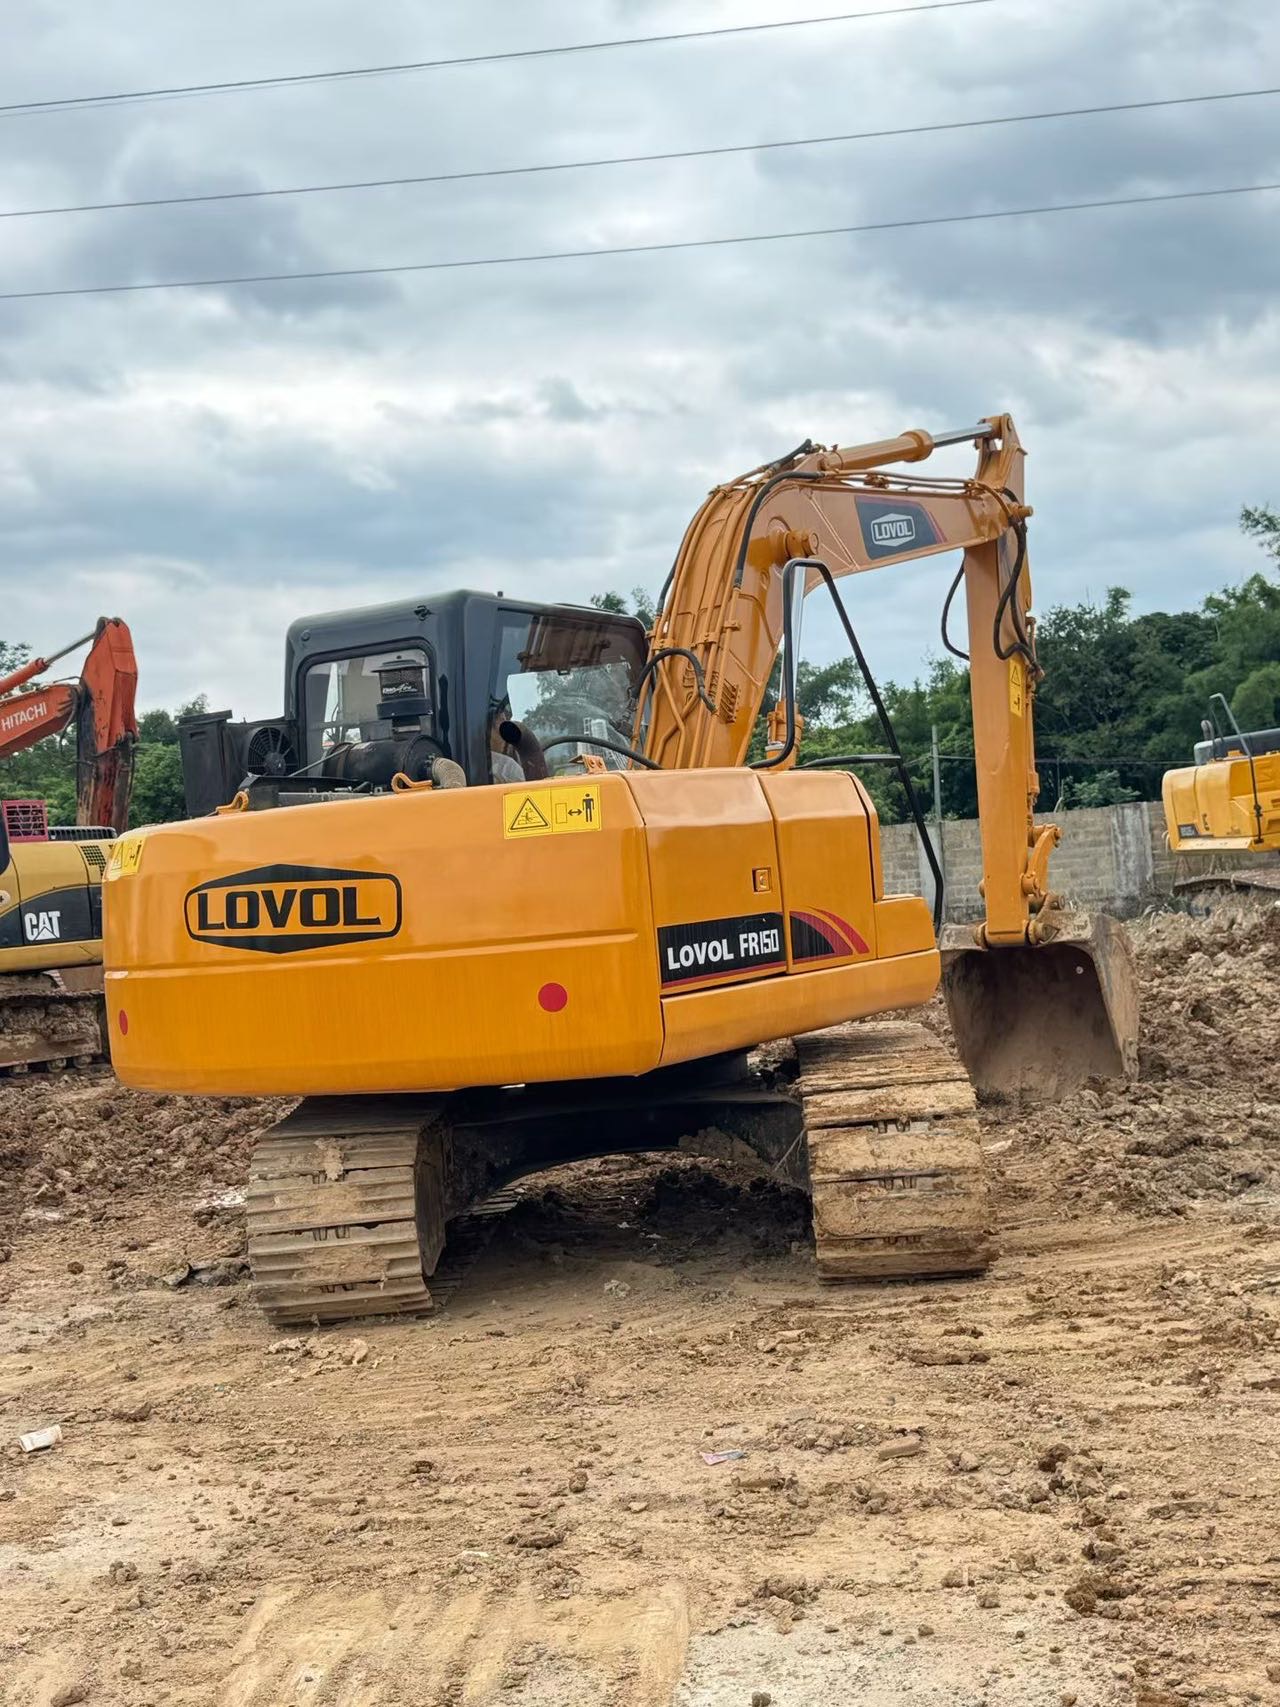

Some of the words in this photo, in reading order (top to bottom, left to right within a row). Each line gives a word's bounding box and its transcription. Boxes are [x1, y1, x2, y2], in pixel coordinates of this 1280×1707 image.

[873, 521, 912, 540] LOVOL
[1, 701, 47, 731] HITACHI
[197, 887, 381, 931] LOVOL
[24, 910, 60, 941] CAT
[667, 938, 734, 970] LOVOL
[739, 928, 780, 958] FR150
